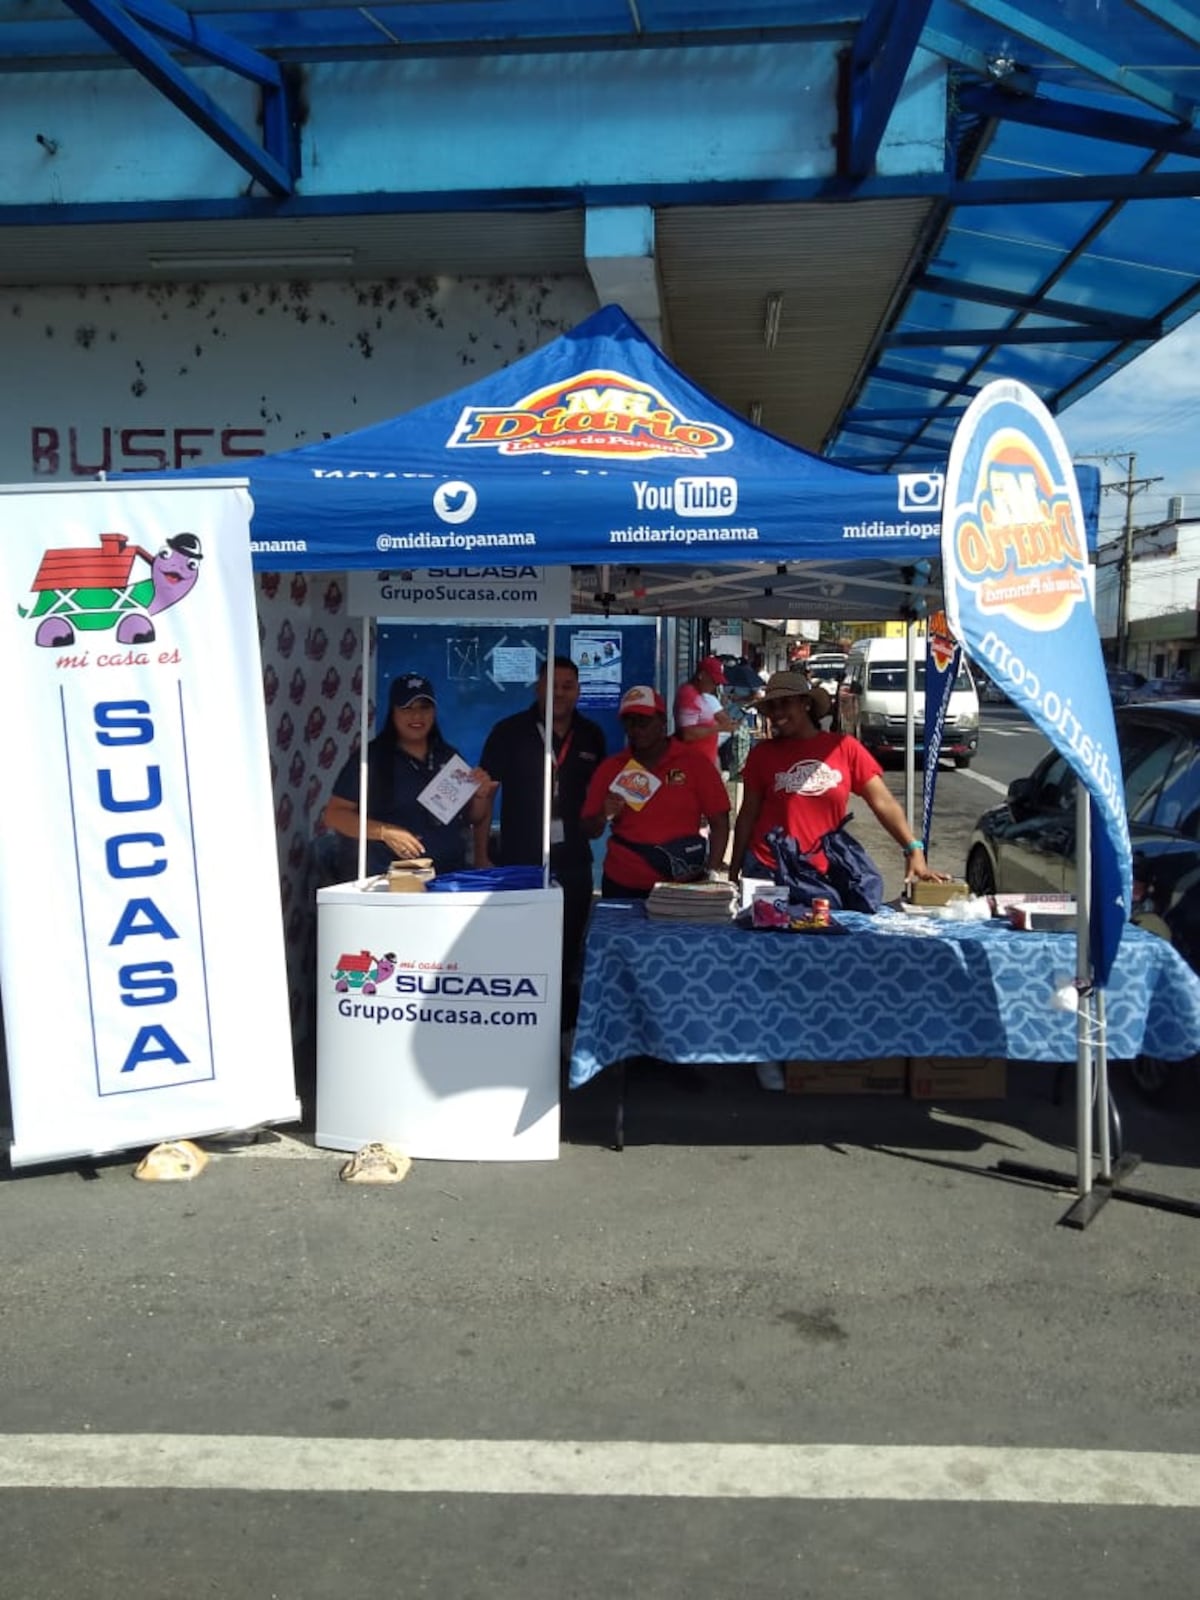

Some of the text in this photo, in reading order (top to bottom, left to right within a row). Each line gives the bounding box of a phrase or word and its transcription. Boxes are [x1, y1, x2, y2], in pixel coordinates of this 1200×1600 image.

[565, 388, 651, 417] Mi
[467, 408, 718, 446] Diario
[580, 435, 606, 444] de
[376, 532, 536, 550] @midiariopanama
[610, 526, 759, 544] midiariopanama
[381, 585, 537, 604] GrupoSucasa.com
[56, 648, 181, 669] mi casa es
[94, 700, 190, 1072] SUCASA
[418, 961, 444, 970] casa
[396, 975, 539, 997] SUCASA
[338, 999, 537, 1026] GrupoSucasa.com
